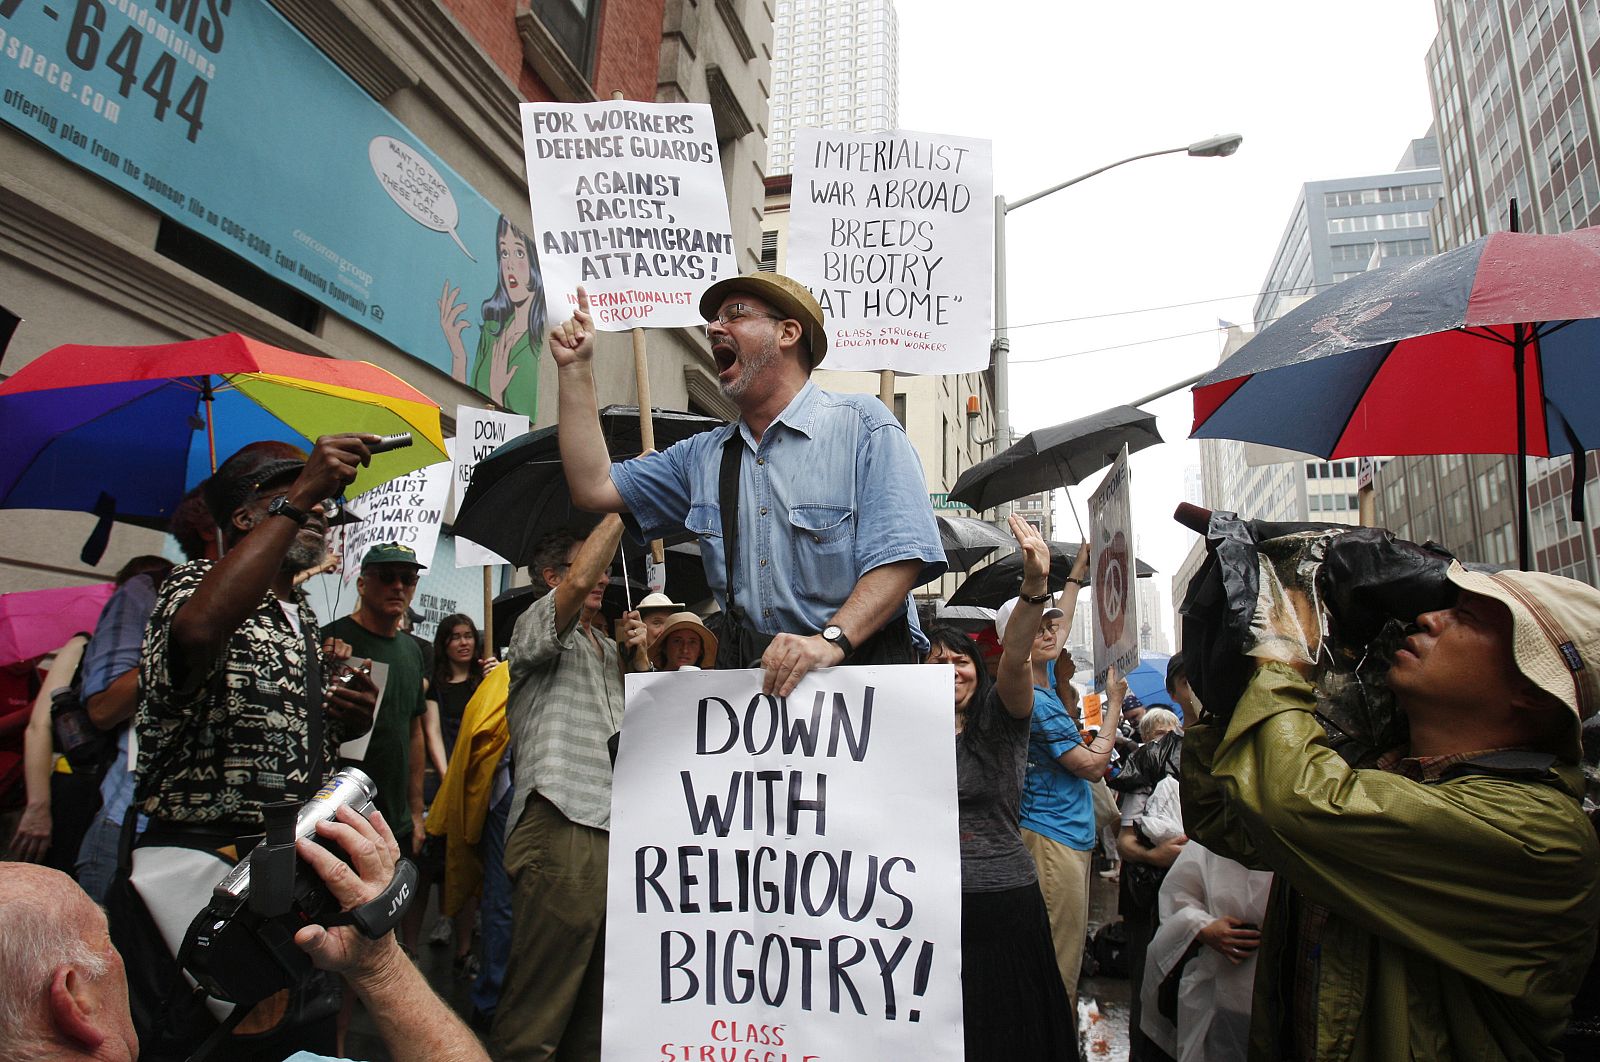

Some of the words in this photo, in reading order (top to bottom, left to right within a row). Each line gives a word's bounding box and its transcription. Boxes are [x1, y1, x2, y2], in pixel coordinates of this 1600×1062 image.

[533, 111, 578, 134] FOR
[584, 110, 694, 134] WORKERS
[536, 135, 625, 159] DEFENSE
[629, 136, 714, 164] GUARDS
[815, 139, 970, 174] IMPERIALIST
[389, 141, 412, 164] WANT
[414, 162, 425, 176] TO
[427, 173, 448, 195] TAKE
[396, 162, 404, 171] A
[406, 169, 440, 200] CLOSER
[382, 172, 410, 201] THESE
[400, 175, 423, 198] LOOK
[424, 196, 435, 206] AT
[575, 171, 680, 196] AGAINST
[811, 179, 856, 207] WAR
[866, 178, 970, 214] ABROAD
[4, 88, 57, 134] offering
[60, 122, 88, 149] plan
[91, 138, 119, 168] from
[123, 157, 140, 180] the
[275, 250, 297, 273] Equal
[298, 263, 327, 293] Housing
[328, 281, 367, 316] Opportunity
[576, 198, 676, 224] RACIST,
[543, 227, 733, 254] ANTI-IMMIGRANT
[831, 218, 934, 252] BREEDS
[339, 257, 373, 288] group
[581, 252, 718, 281] ATTACKS!
[823, 251, 943, 290] BIGOTRY
[567, 290, 693, 308] INERNATIONALIST
[864, 287, 963, 325] HOME"
[600, 305, 654, 323] GROUP
[835, 338, 899, 348] EDUCATION
[904, 341, 948, 352] WORKERS
[837, 328, 872, 338] CLASS
[880, 327, 931, 340] STRUGGLE
[475, 420, 506, 442] DOWN
[473, 445, 499, 461] WIT
[370, 494, 401, 511] WAR
[409, 494, 424, 507] &
[382, 508, 413, 524] WAR
[417, 509, 441, 525] ON
[696, 686, 875, 762] DOWN
[680, 770, 827, 837] WITH
[389, 883, 410, 917] JVC
[635, 845, 916, 930] RELIGIOUS
[660, 929, 934, 1022] BIGOTRY!
[711, 1019, 786, 1047] CLASS
[660, 1043, 823, 1062] STRUG
